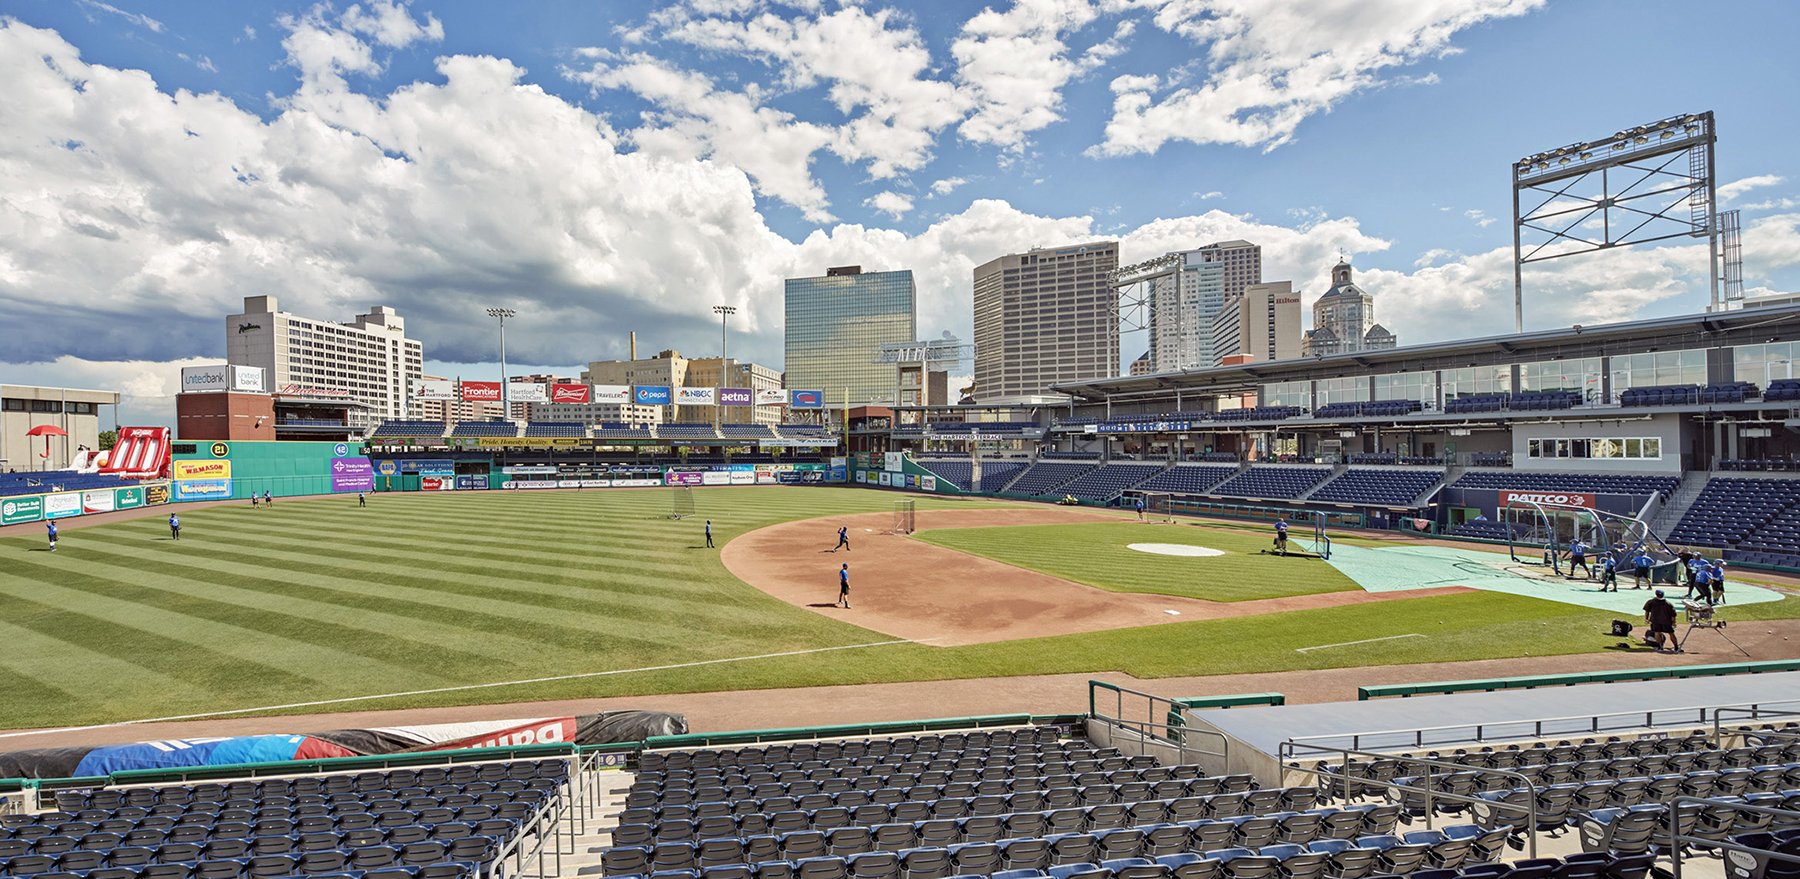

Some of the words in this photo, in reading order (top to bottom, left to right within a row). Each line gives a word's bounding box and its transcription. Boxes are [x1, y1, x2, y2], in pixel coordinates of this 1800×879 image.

[240, 378, 259, 387] bank
[464, 386, 499, 396] Frontier
[649, 391, 667, 401] pepsi
[721, 392, 750, 401] aetna
[214, 445, 225, 454] 21
[1507, 493, 1568, 504] DATTCO
